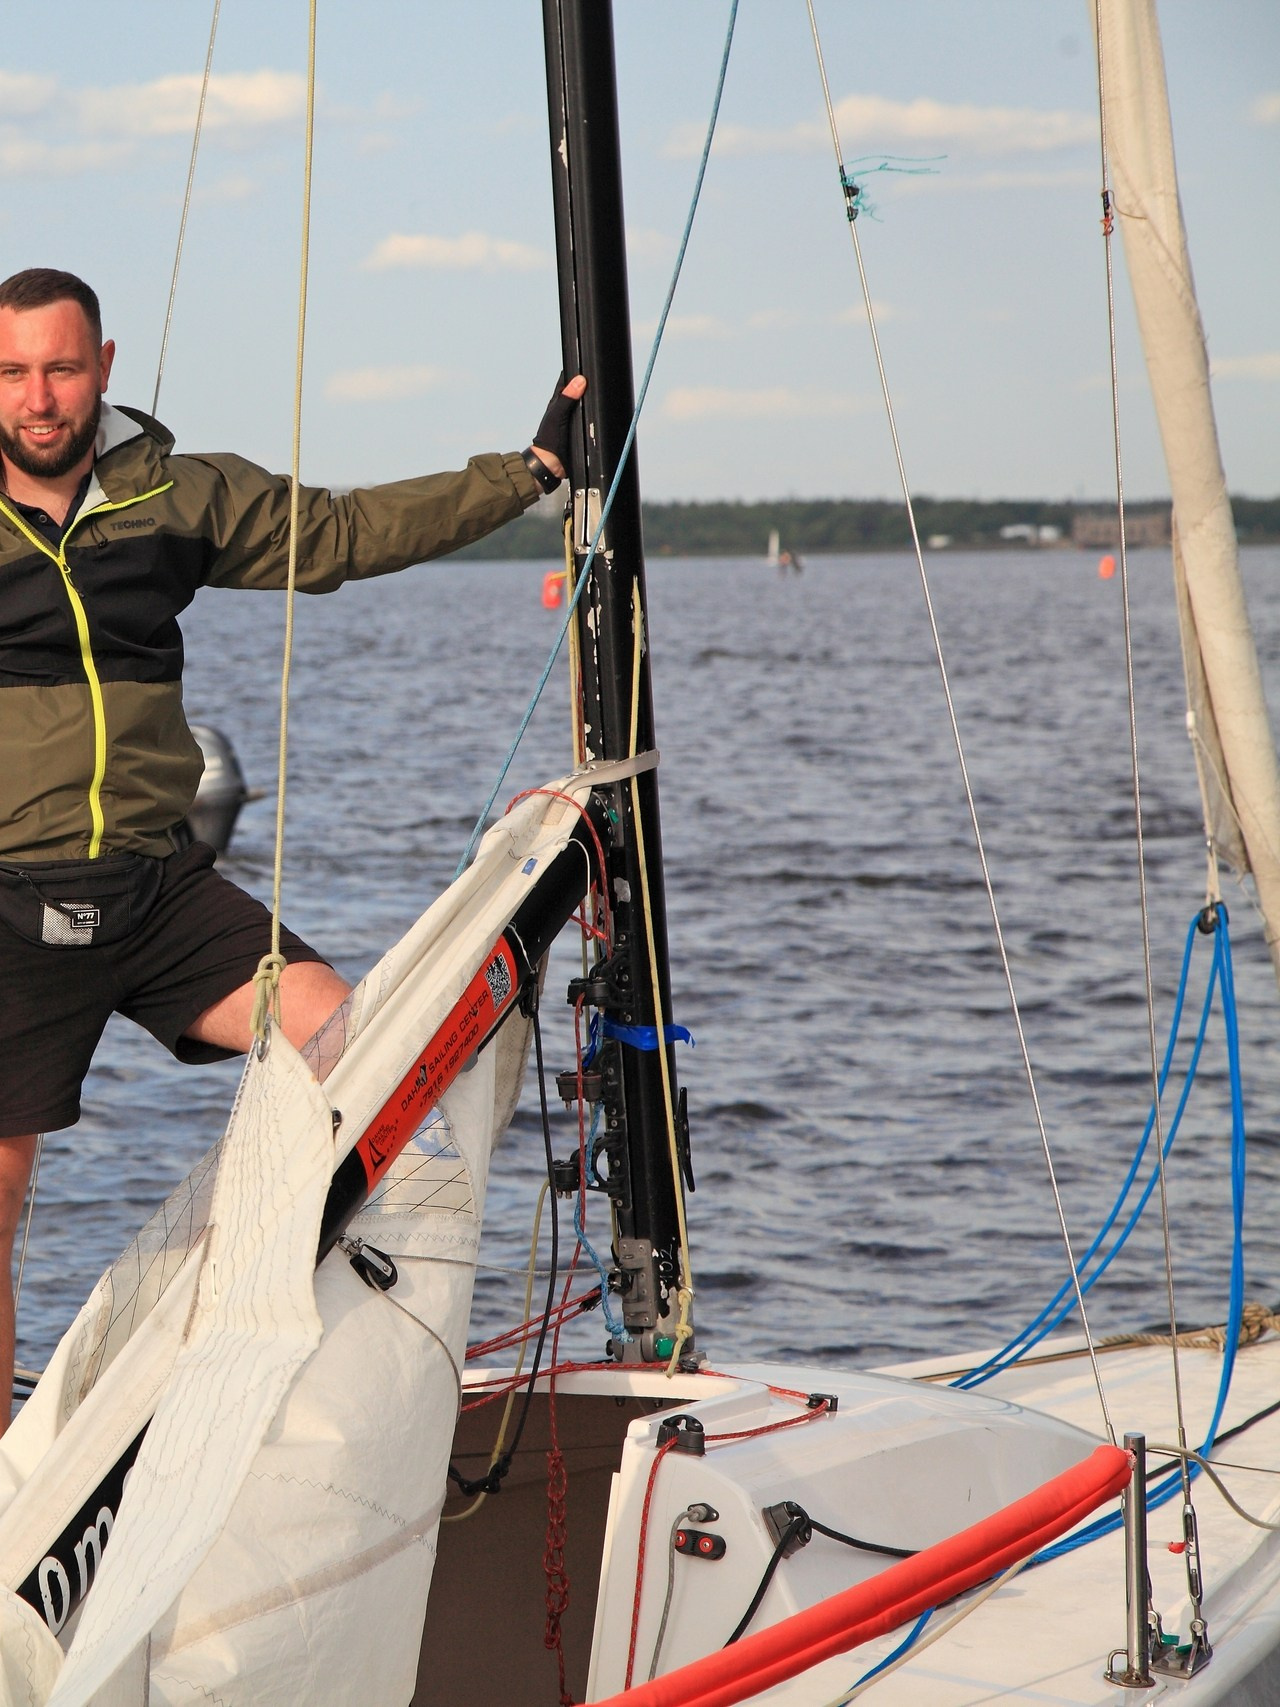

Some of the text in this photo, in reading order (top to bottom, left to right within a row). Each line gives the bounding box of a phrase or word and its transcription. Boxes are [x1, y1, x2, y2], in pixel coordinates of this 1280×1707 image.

[428, 1032, 458, 1074] SAILING
[459, 989, 489, 1031] CENTER
[444, 1023, 480, 1073] 1927400
